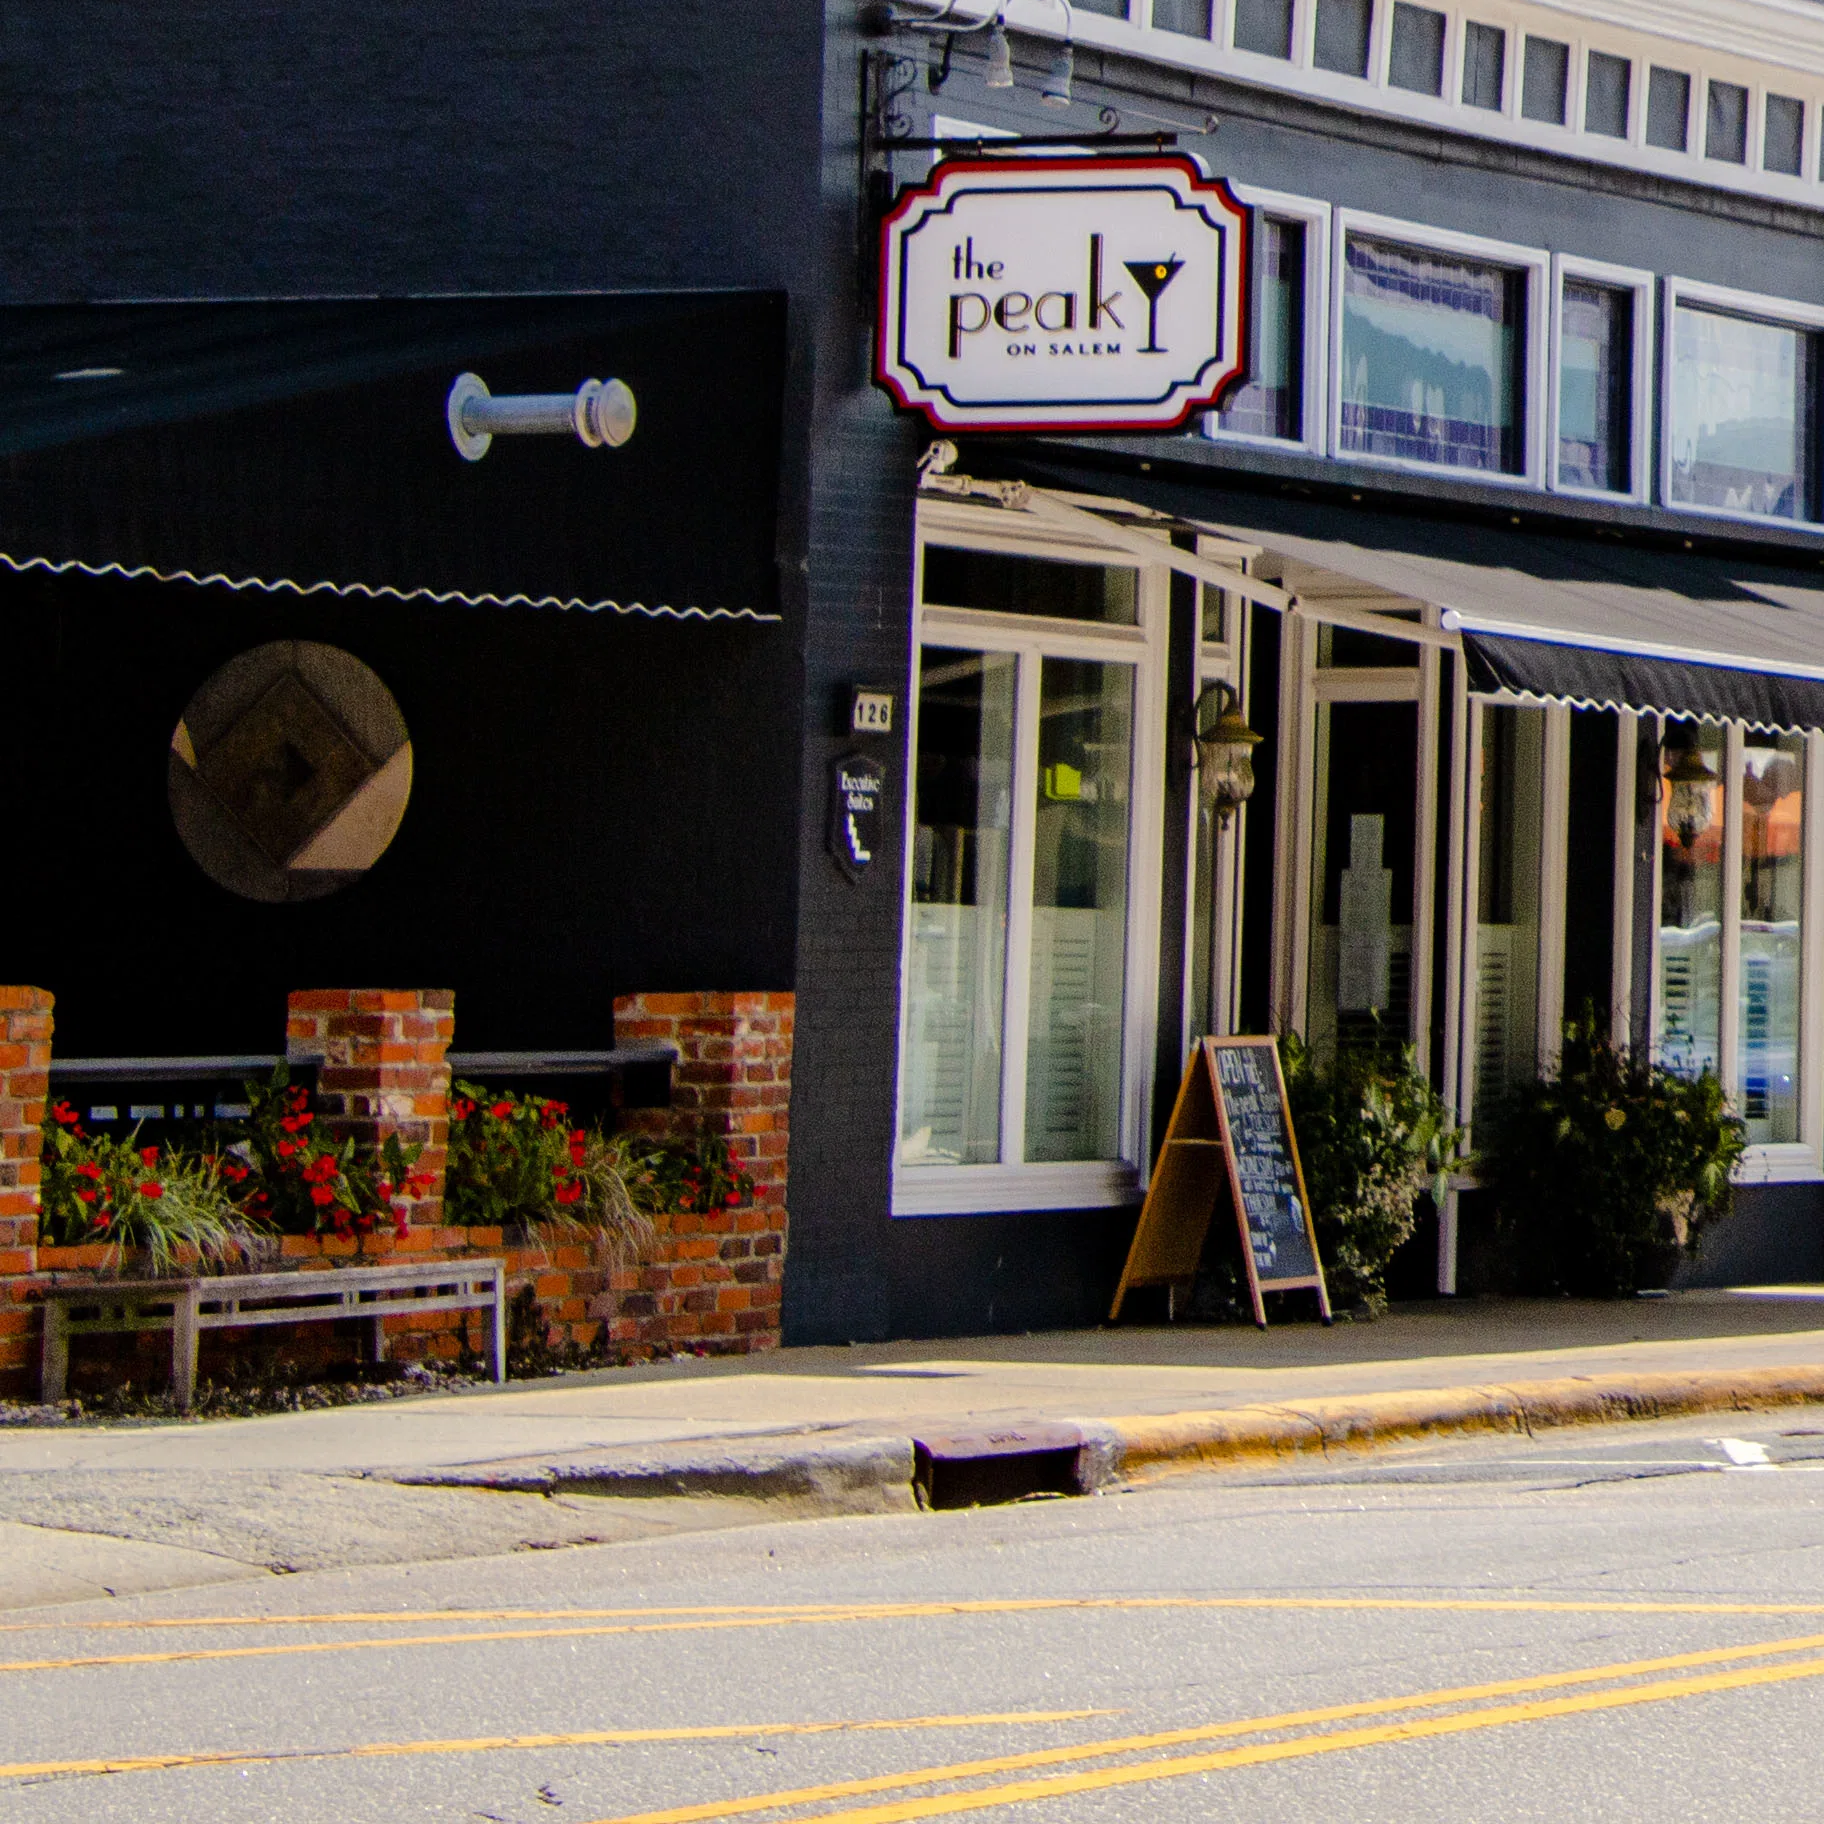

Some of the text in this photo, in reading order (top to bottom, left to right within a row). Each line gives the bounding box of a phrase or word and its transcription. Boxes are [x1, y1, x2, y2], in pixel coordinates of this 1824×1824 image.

[952, 236, 1005, 280] the
[948, 233, 1125, 359] peak
[1006, 341, 1122, 357] ON SALEM
[856, 702, 889, 724] 126
